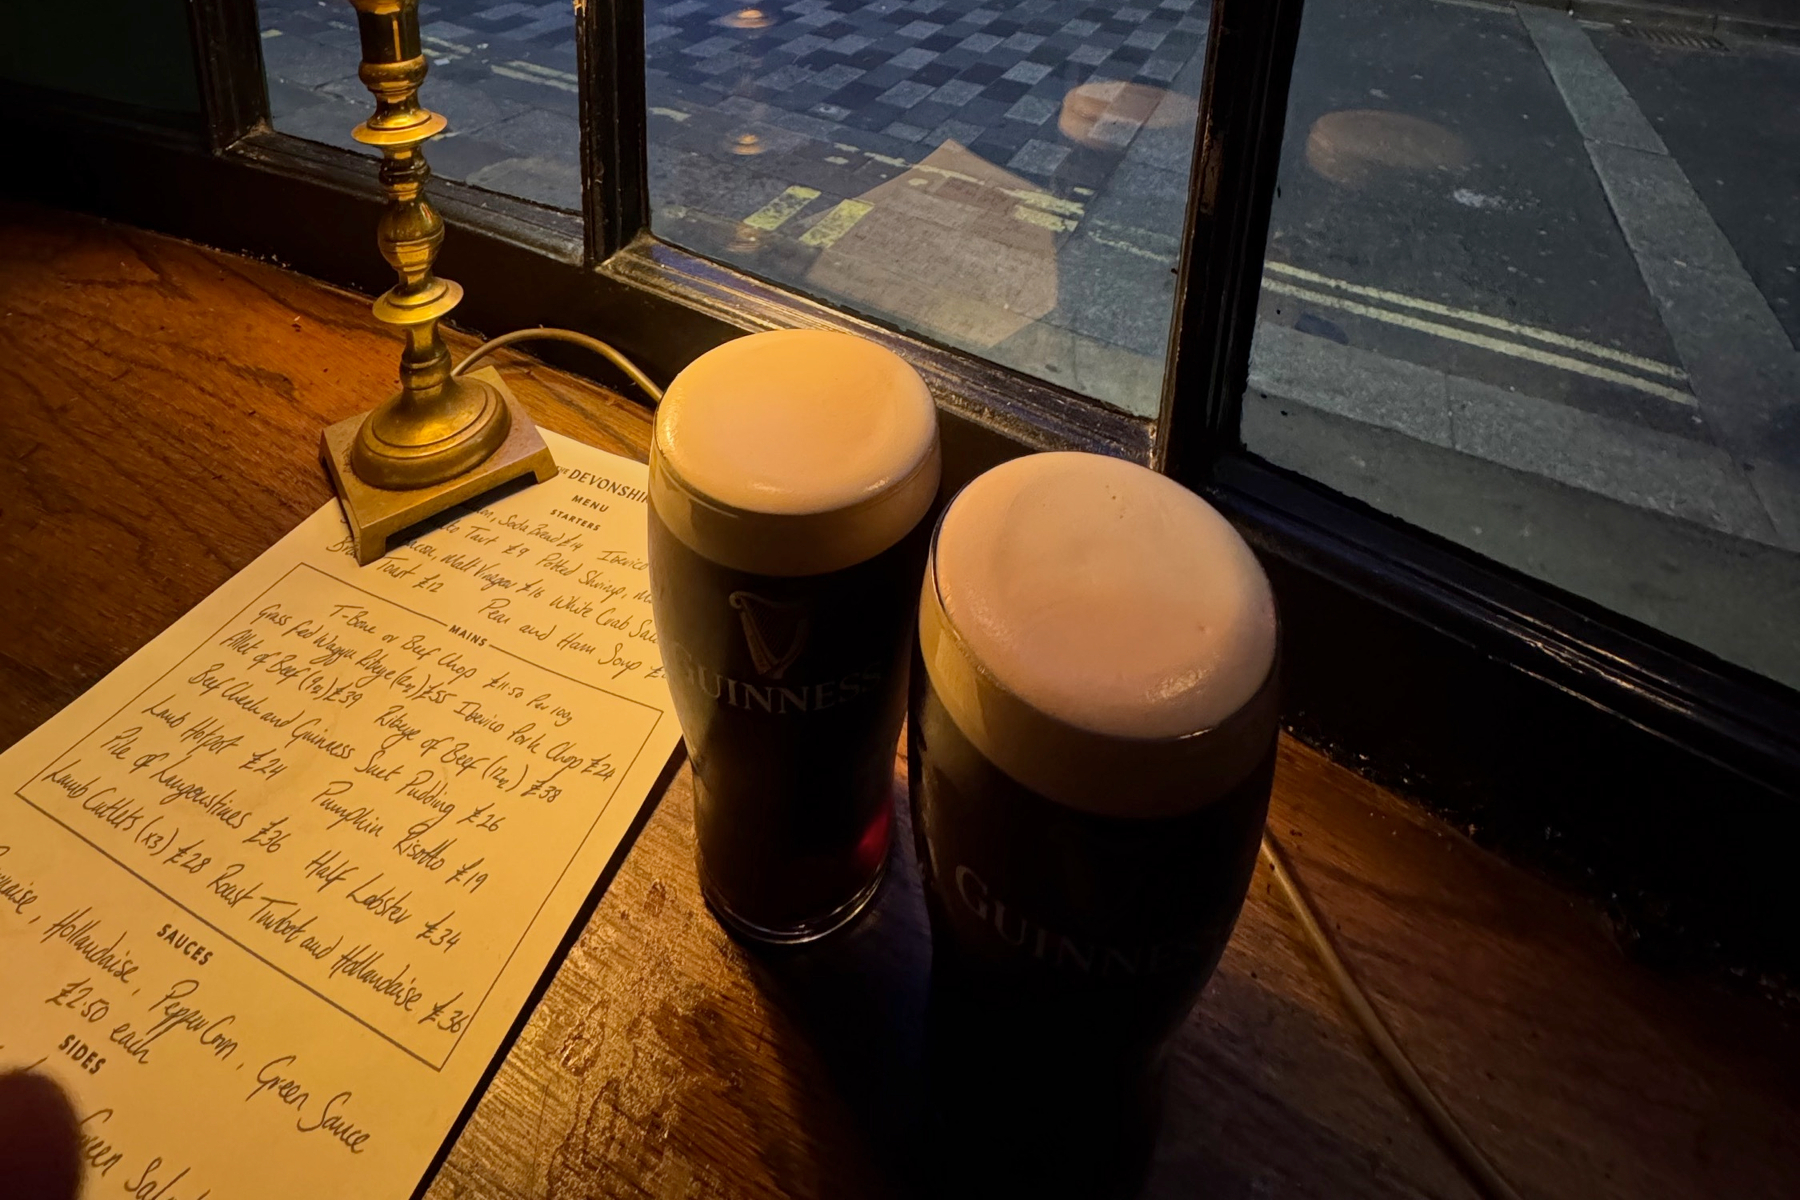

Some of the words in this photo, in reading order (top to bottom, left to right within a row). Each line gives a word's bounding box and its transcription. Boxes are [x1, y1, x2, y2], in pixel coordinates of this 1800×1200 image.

[464, 525, 501, 546] Tart
[501, 543, 530, 557] £9
[535, 552, 584, 577] Potted
[527, 523, 566, 548] Bread
[556, 533, 584, 553] £14
[550, 509, 601, 532] STARTERS
[572, 494, 609, 513] MENU
[377, 556, 423, 580] Toast
[412, 573, 445, 593] £12
[519, 624, 558, 641] and
[556, 632, 597, 655] Ham
[598, 642, 643, 680] Soup
[404, 540, 437, 561] acon,
[515, 579, 545, 599] £16
[549, 595, 595, 619] White
[595, 607, 634, 631] Crab
[448, 625, 489, 647] MAINS
[219, 629, 265, 655] Fillet
[246, 651, 283, 670] of
[265, 654, 312, 686] Beef
[322, 681, 364, 709] £39
[373, 705, 421, 751] Ribeye
[419, 736, 455, 757] of
[440, 742, 491, 777] Beef
[520, 779, 562, 804] £38
[249, 603, 293, 626] Grass
[309, 632, 358, 667] Wagyu
[354, 648, 397, 689] Ribeye
[411, 681, 458, 705] £55
[453, 701, 505, 734] Iberico
[506, 722, 547, 754] Pork
[543, 741, 584, 782] Chop
[580, 753, 616, 782] £24
[329, 605, 378, 635] T-Bone
[382, 634, 401, 644] or
[400, 634, 442, 661] Beef
[437, 652, 477, 686] Chop
[549, 706, 573, 727] 100g
[141, 694, 192, 728] Lamb
[179, 716, 245, 756] Hotpot
[238, 748, 288, 781] £24
[311, 780, 384, 837] Pumpkin
[392, 818, 458, 871] Risotto
[444, 857, 489, 894] £19
[187, 663, 236, 697] Beef
[221, 681, 269, 715] Cheek
[259, 709, 306, 729] and
[284, 718, 356, 759] Guinness
[353, 750, 405, 782] Suet
[395, 769, 456, 840] Pudding
[456, 802, 506, 832] £26
[100, 726, 144, 760] Pile
[128, 752, 170, 774] of
[149, 754, 253, 830] Langoustines
[242, 816, 292, 854] £36
[304, 849, 360, 893] Half
[345, 872, 413, 925] Lobster
[415, 910, 462, 954] £34
[41, 758, 102, 799] Lamb
[82, 787, 145, 831] Cutlets
[162, 839, 213, 874] £28
[206, 863, 264, 908] Roast
[249, 896, 319, 944] Turbot
[299, 935, 344, 960] and
[327, 943, 424, 1012] Hollandaise
[416, 991, 471, 1035] £36
[156, 923, 215, 967] SAUCES
[40, 906, 142, 997] Hollandaise,
[245, 1055, 310, 1112] Green
[296, 1091, 372, 1154] Sauce
[58, 1034, 108, 1076] SIDES
[109, 1022, 152, 1065] each
